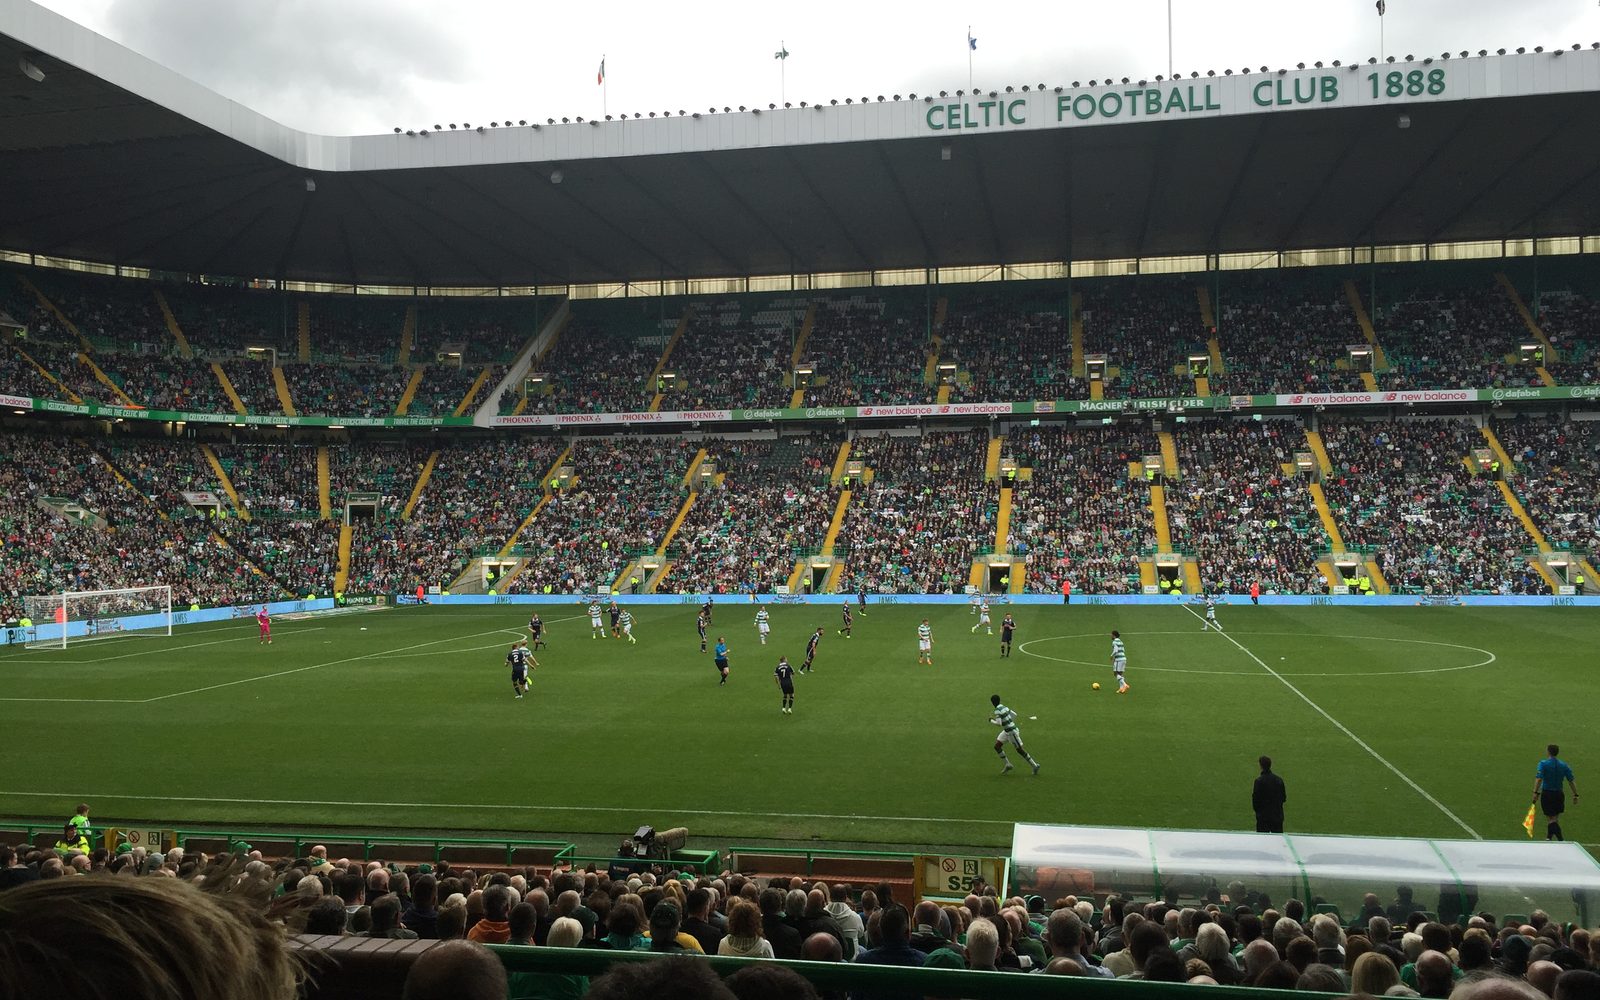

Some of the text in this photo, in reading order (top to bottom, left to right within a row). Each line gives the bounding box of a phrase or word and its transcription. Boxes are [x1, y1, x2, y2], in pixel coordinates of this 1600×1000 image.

[926, 68, 1446, 130] CELTIC FOOTBALL CLUB 1888
[1329, 394, 1371, 403] balance
[1401, 391, 1467, 401] new balance
[1505, 389, 1541, 399] dafabet
[973, 404, 1011, 413] balance
[1079, 399, 1204, 411] MAGNERS IRISH CIDER
[753, 409, 782, 418] dafabet
[816, 408, 845, 417] dafabet
[896, 406, 932, 415] balance
[502, 416, 534, 424] PHOENIX
[561, 415, 594, 423] PHOENIX
[622, 413, 654, 421] PHOENIX
[683, 411, 716, 420] PHOENIX
[494, 596, 513, 605] JAMES
[681, 596, 701, 604] JAMES
[878, 596, 898, 604] JAMES
[1087, 596, 1108, 604] JAMES
[1310, 596, 1333, 605] JAMES
[1551, 597, 1575, 606] JAMES
[172, 612, 188, 625] JAMES
[513, 654, 519, 663] 2
[780, 668, 786, 678] 7
[947, 875, 973, 891] S5
